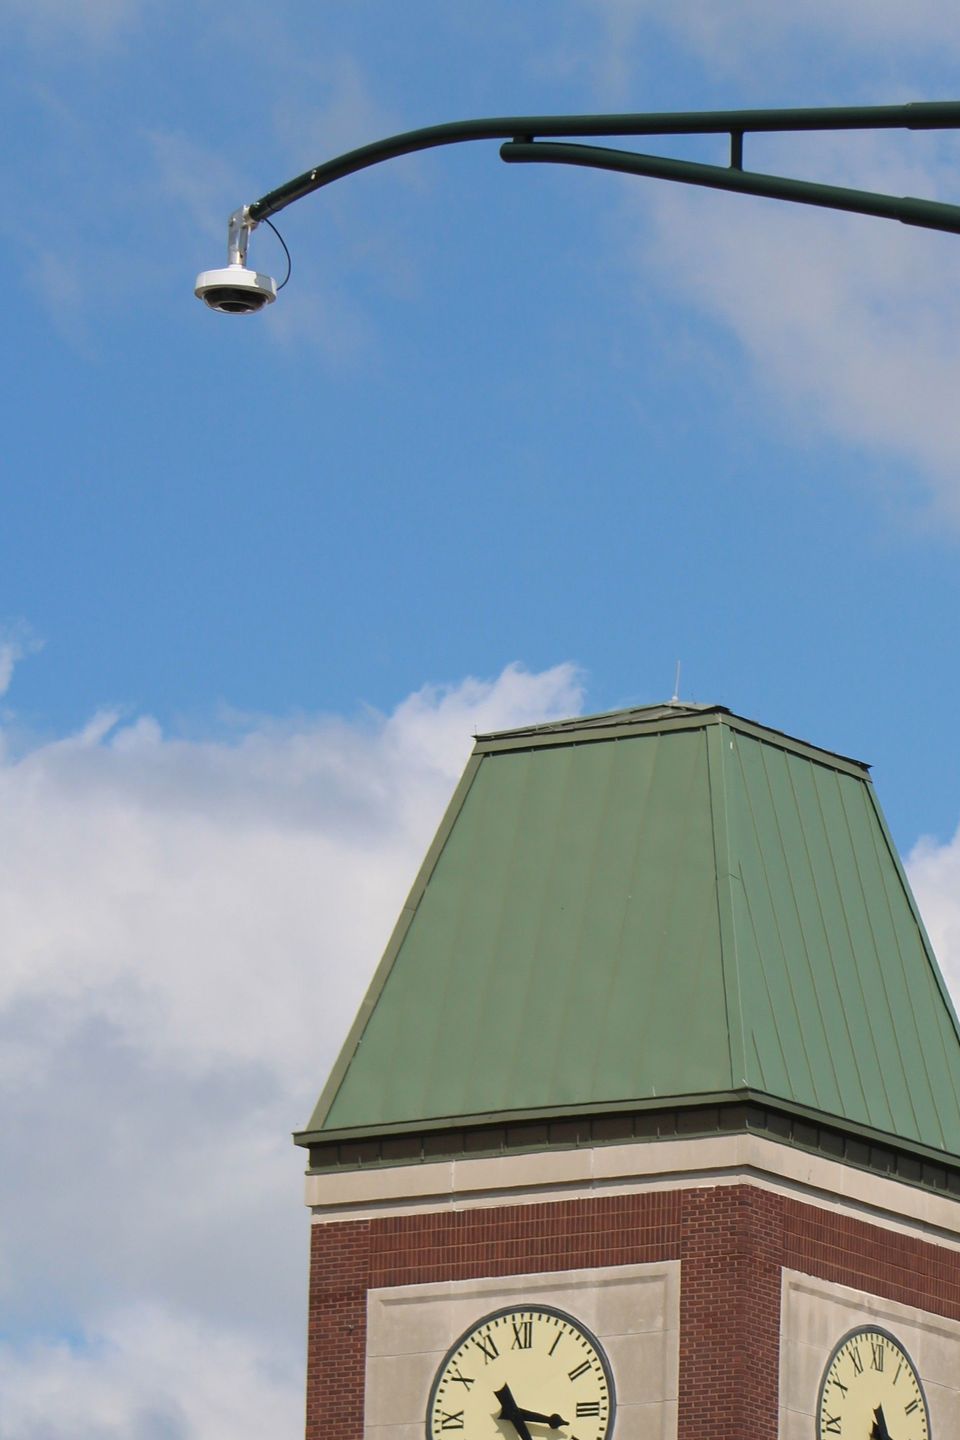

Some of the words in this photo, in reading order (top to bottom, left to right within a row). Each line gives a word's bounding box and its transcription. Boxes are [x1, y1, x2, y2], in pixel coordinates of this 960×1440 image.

[511, 1321, 532, 1350] XII
[548, 1331, 564, 1356] I
[476, 1334, 500, 1365] XI
[848, 1345, 864, 1377] XI
[870, 1342, 884, 1372] XII
[451, 1368, 475, 1391] X
[567, 1360, 592, 1382] II
[893, 1363, 902, 1385] I
[832, 1372, 848, 1399] X
[576, 1401, 600, 1418] III
[904, 1399, 919, 1416] II
[441, 1410, 464, 1430] IX
[826, 1412, 841, 1435] IX
